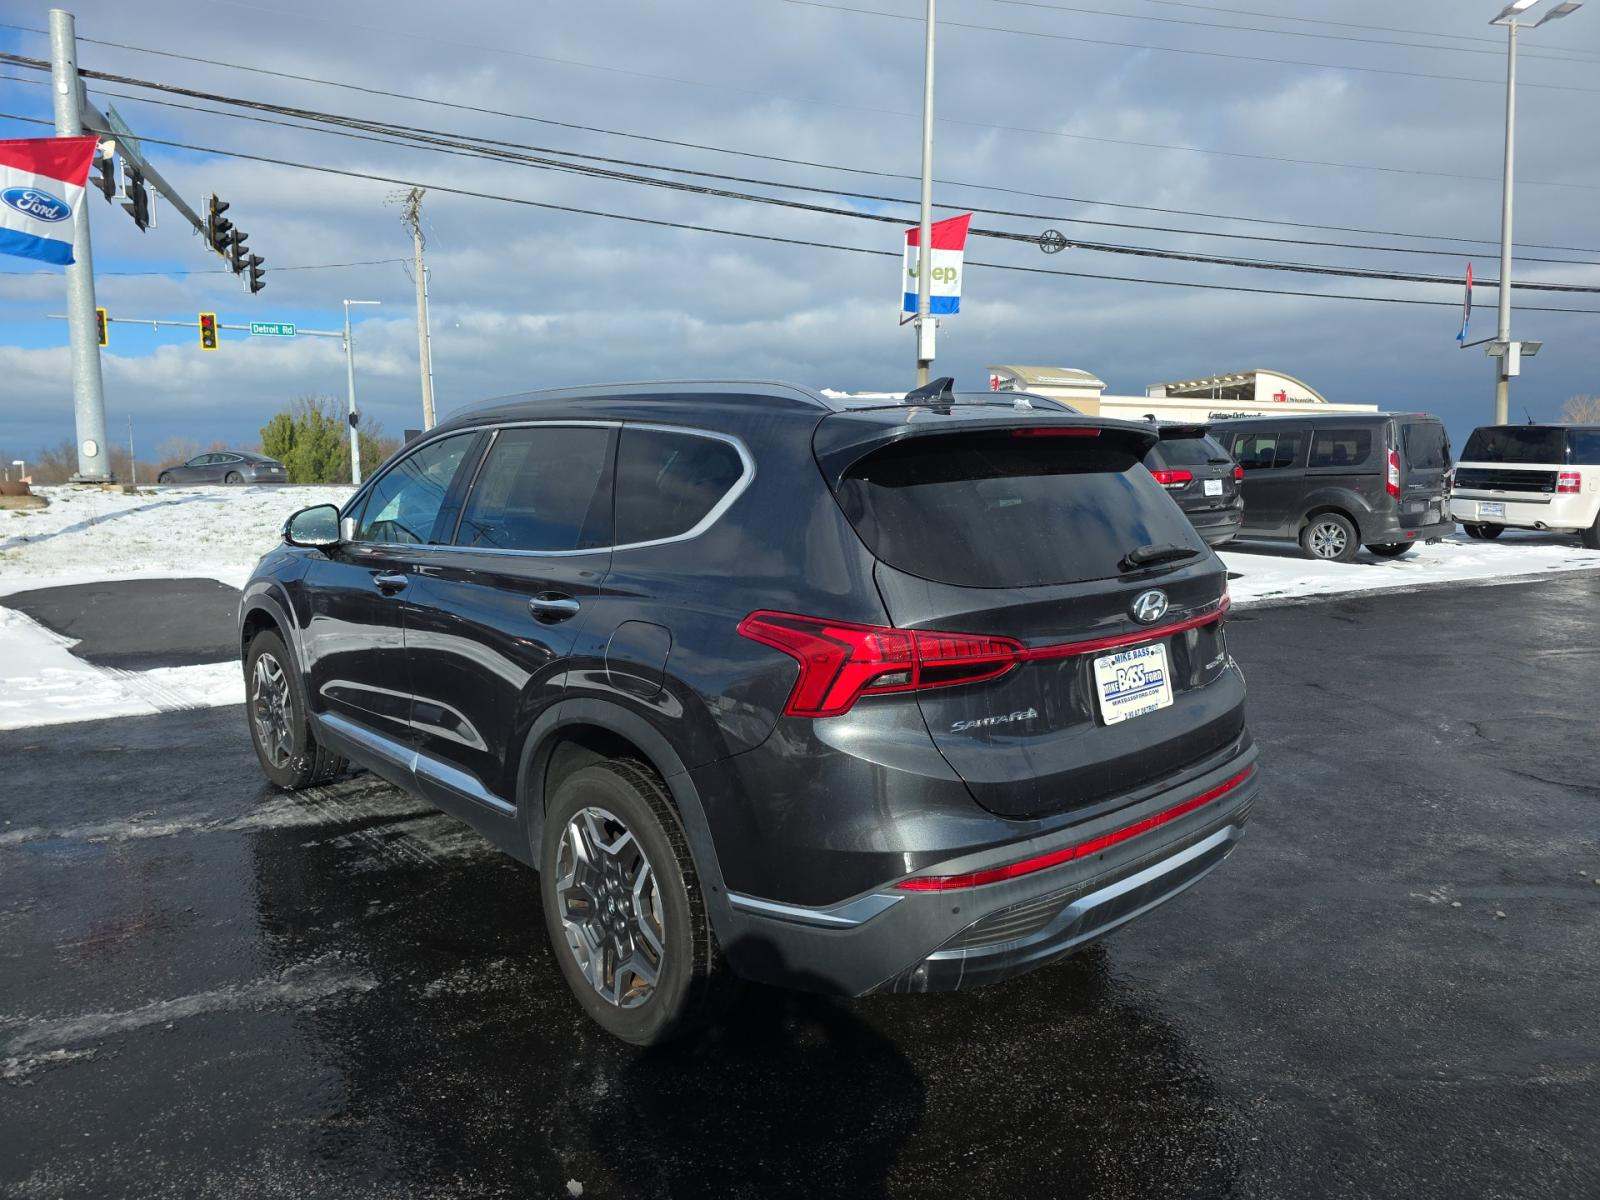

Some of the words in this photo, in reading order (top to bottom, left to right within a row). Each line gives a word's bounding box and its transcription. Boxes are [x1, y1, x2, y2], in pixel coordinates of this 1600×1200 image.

[16, 191, 60, 218] Ford
[908, 260, 957, 284] Jep
[253, 324, 279, 334] Detroit
[282, 325, 293, 335] Rd
[1114, 652, 1132, 663] MIKE
[1133, 648, 1150, 659] BASS
[1104, 682, 1119, 694] MIKE
[1116, 663, 1145, 692] BASS
[1145, 672, 1162, 684] FORD
